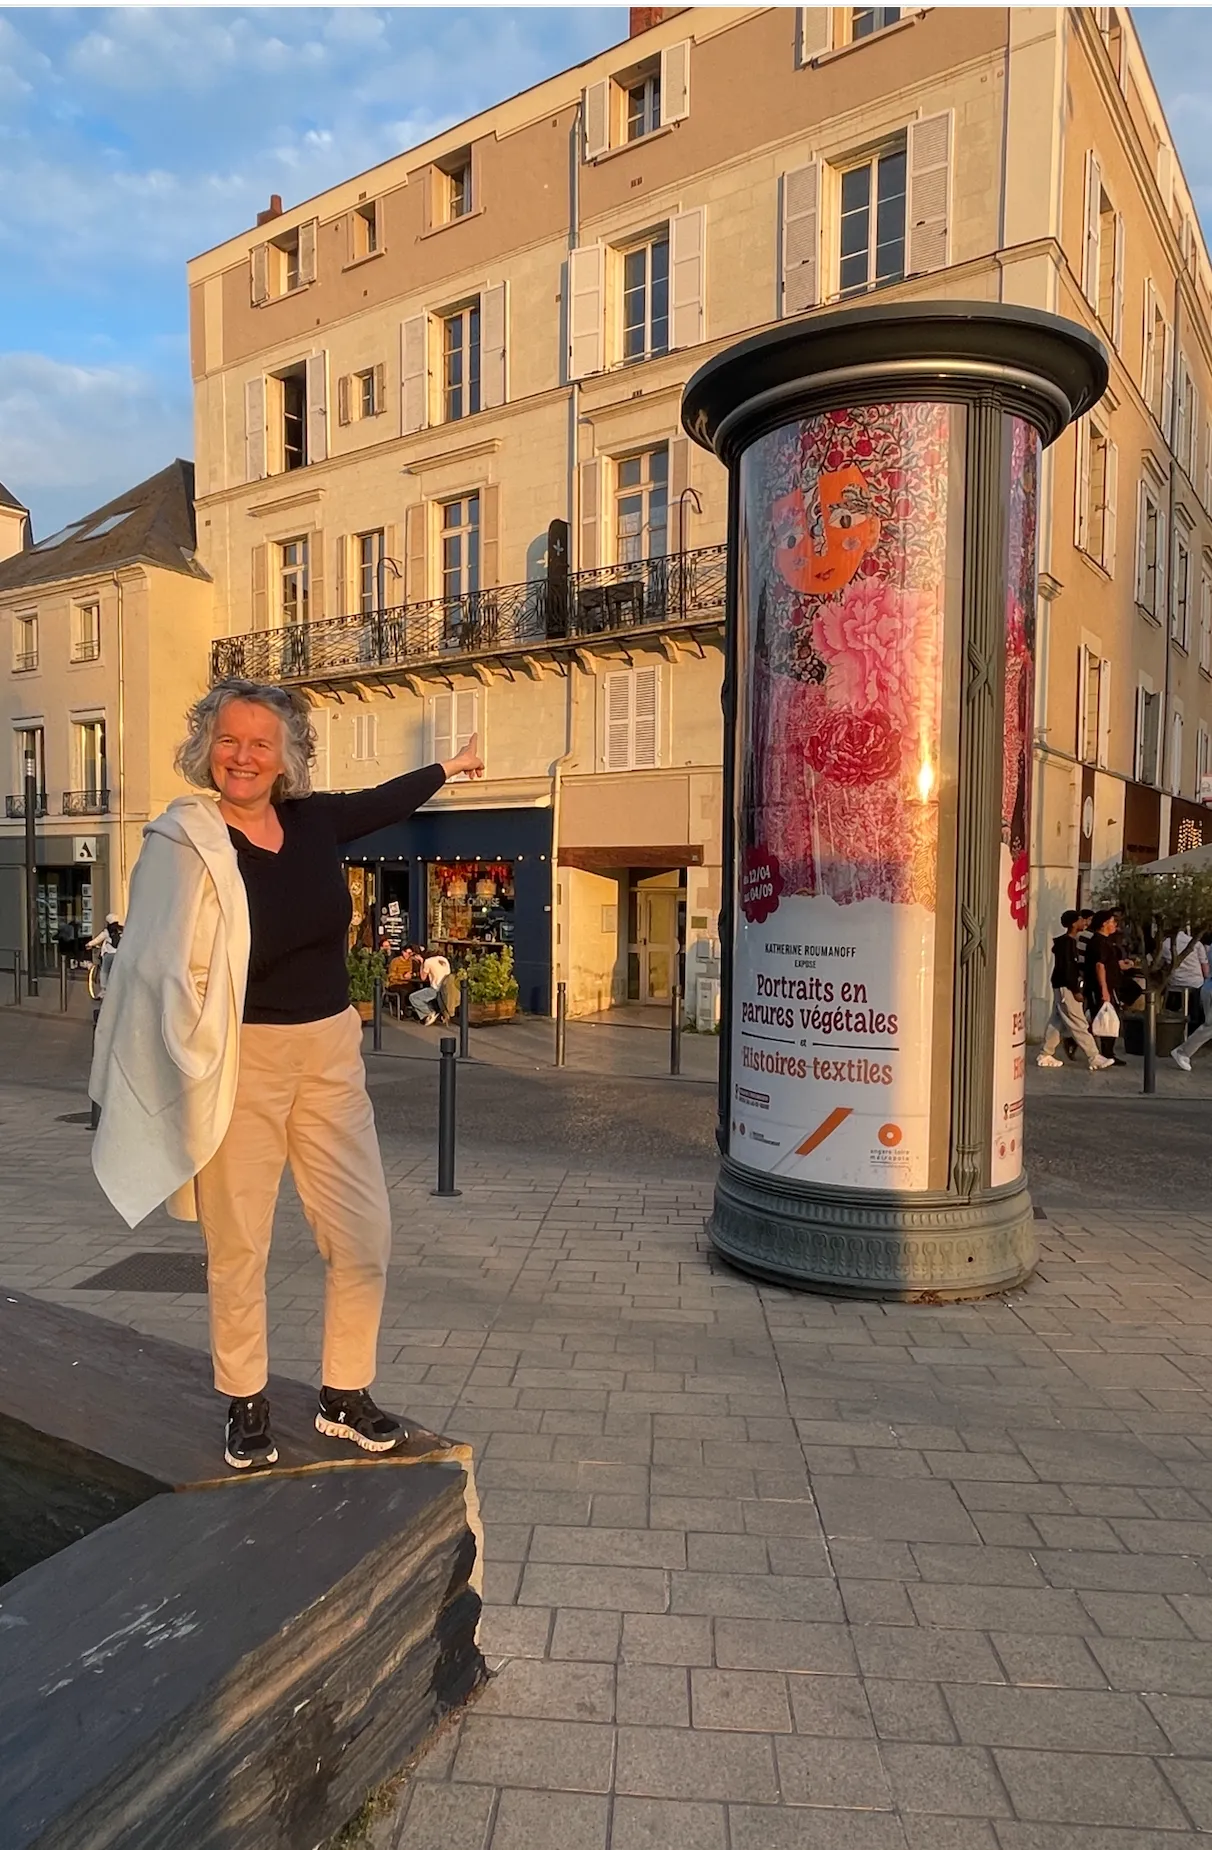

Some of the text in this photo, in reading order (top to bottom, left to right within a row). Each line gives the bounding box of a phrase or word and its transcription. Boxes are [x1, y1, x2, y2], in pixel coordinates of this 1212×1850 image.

[765, 943, 856, 957] KATHERINE ROUMANOFF
[794, 960, 816, 968] EXPOSE
[757, 974, 867, 1003] Portraits en
[800, 1004, 899, 1035] végétales
[743, 1046, 893, 1085] Histoires textiles
